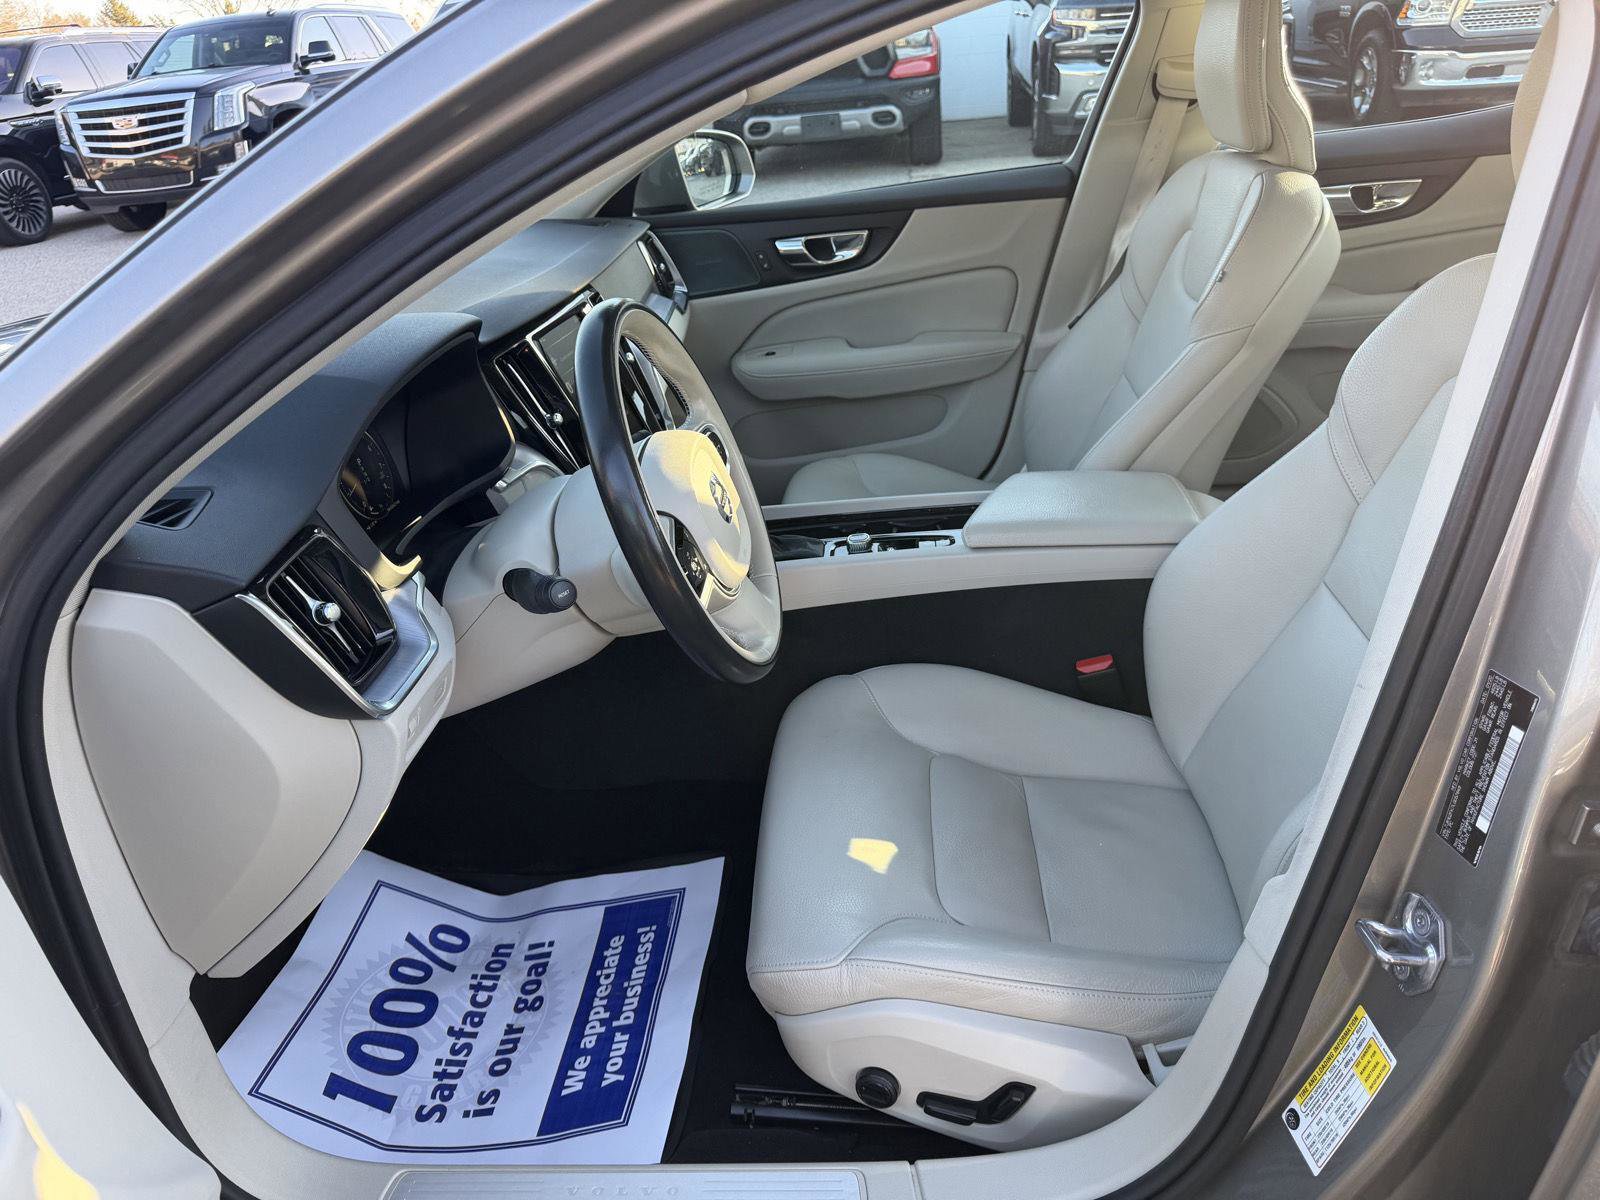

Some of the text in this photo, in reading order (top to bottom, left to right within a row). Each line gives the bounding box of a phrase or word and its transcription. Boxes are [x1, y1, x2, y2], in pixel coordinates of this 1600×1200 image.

[322, 923, 471, 1114] 100%
[414, 942, 515, 1124] Satisfaction
[461, 939, 556, 1119] is our goal!
[560, 934, 625, 1097] We appreciate
[601, 924, 657, 1088] your business!
[1299, 1084, 1310, 1101] TIRE
[1308, 1073, 1318, 1089] AND
[1316, 1050, 1335, 1077] LOADING
[1332, 1014, 1360, 1054] INFORMATION
[566, 1184, 680, 1196] VOLVO
